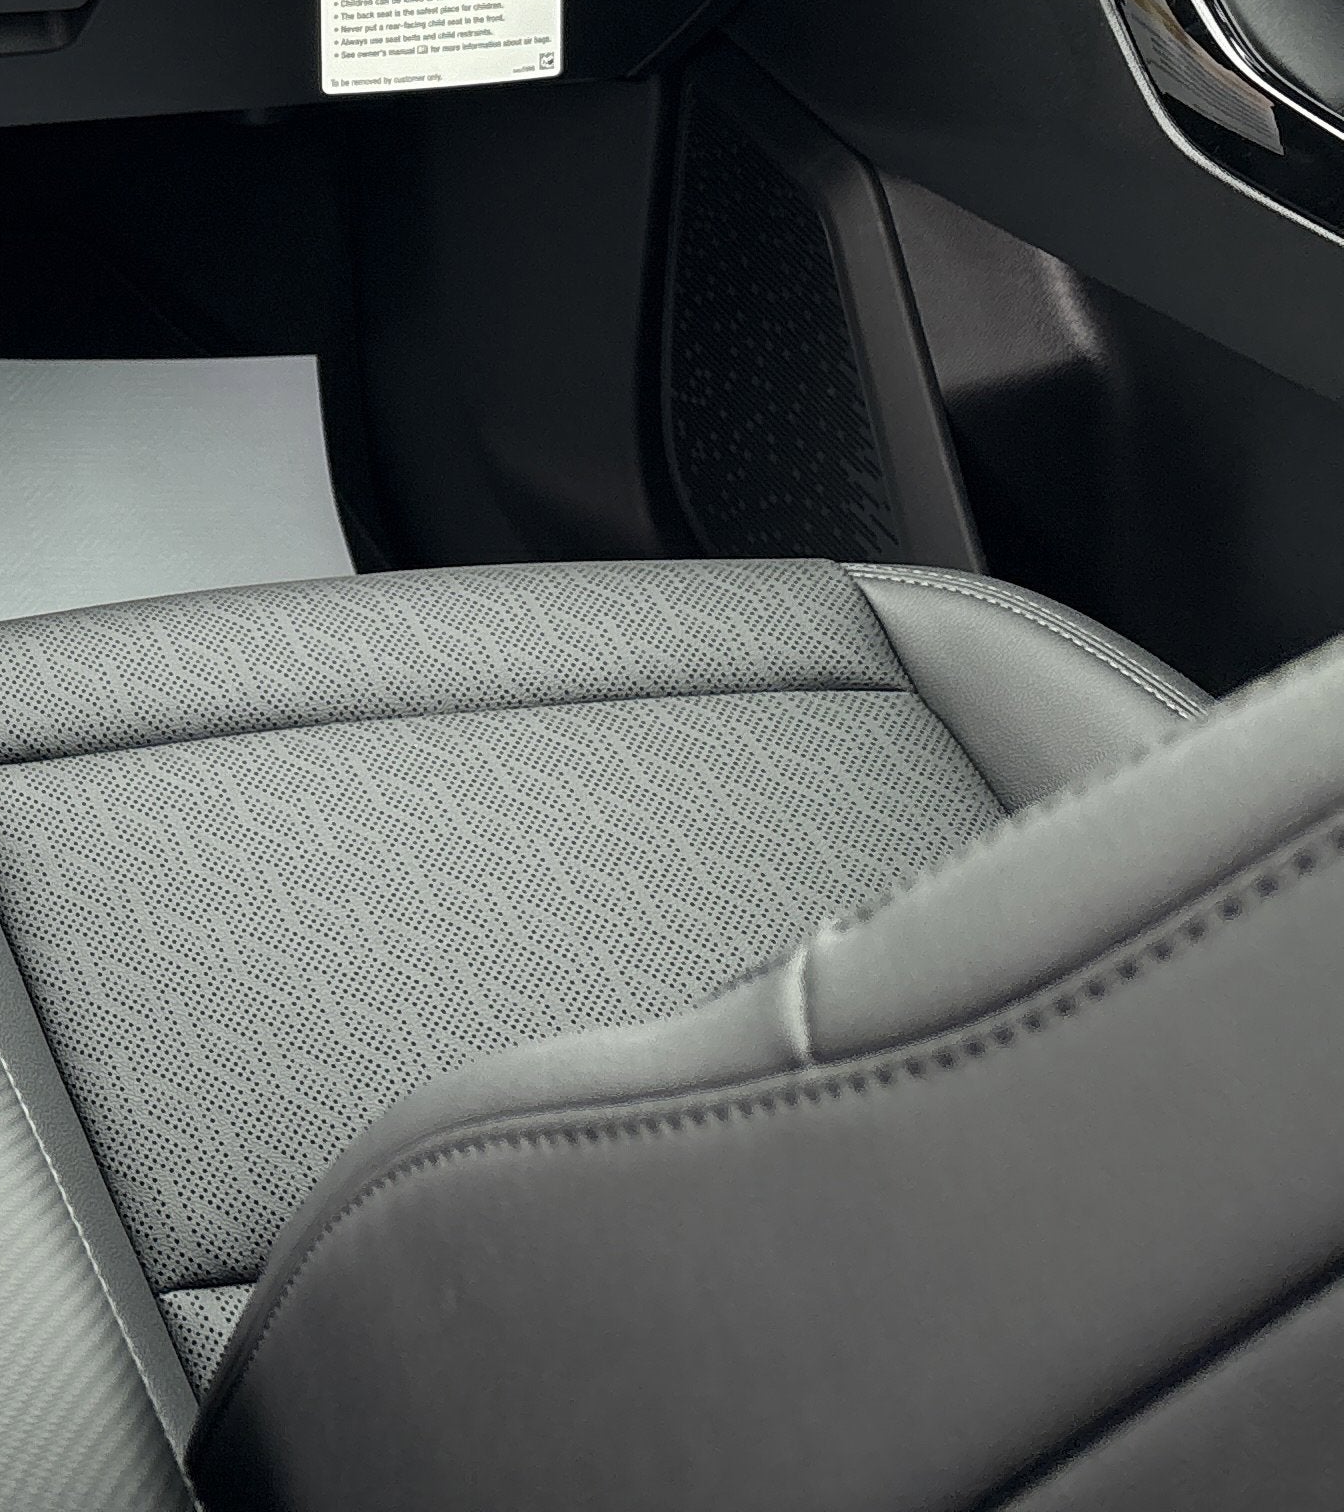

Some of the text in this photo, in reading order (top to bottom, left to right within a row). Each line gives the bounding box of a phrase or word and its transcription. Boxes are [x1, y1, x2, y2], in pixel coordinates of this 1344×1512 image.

[341, 0, 373, 7] Children
[341, 12, 354, 20] The
[341, 38, 367, 46] Always
[331, 79, 339, 87] To
[341, 78, 349, 87] be
[352, 77, 381, 86] removed
[384, 76, 392, 85] by
[394, 74, 425, 84] customer
